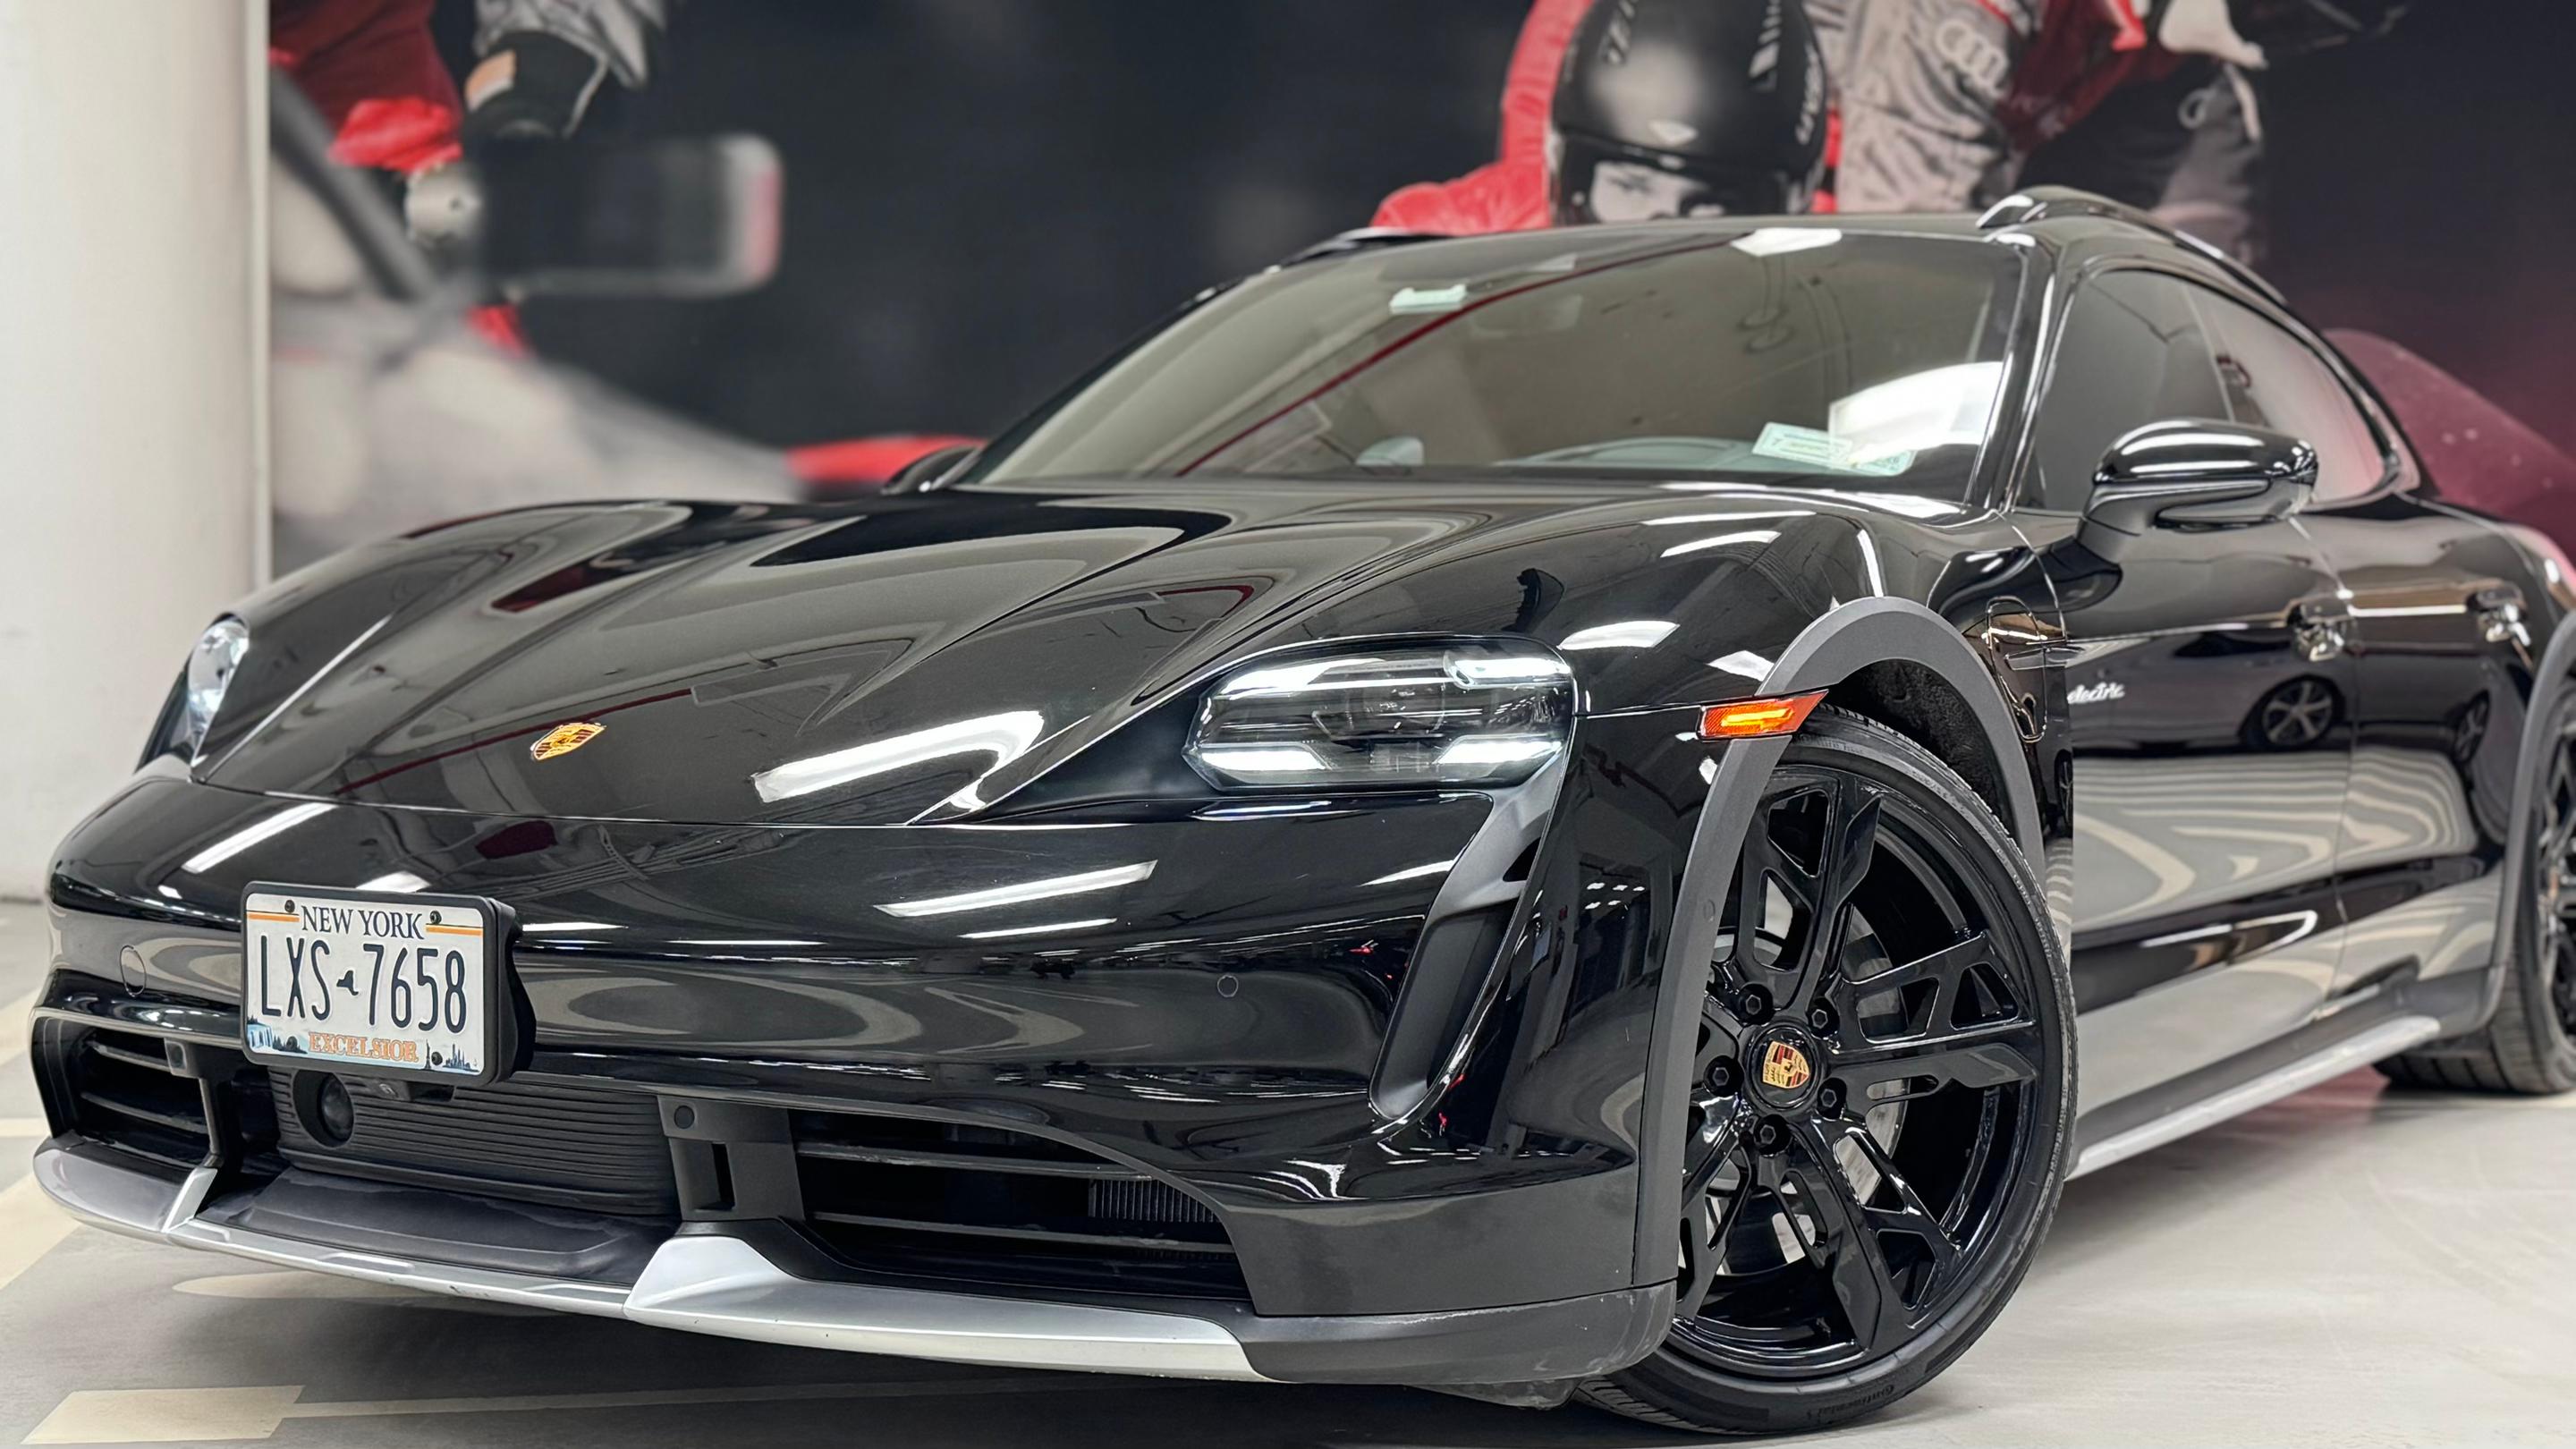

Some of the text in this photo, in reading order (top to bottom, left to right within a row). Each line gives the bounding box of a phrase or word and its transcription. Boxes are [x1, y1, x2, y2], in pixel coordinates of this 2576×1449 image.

[2067, 682, 2125, 704] electric
[301, 905, 425, 940] NEW YORK
[308, 1031, 419, 1063] EXCELSIOR
